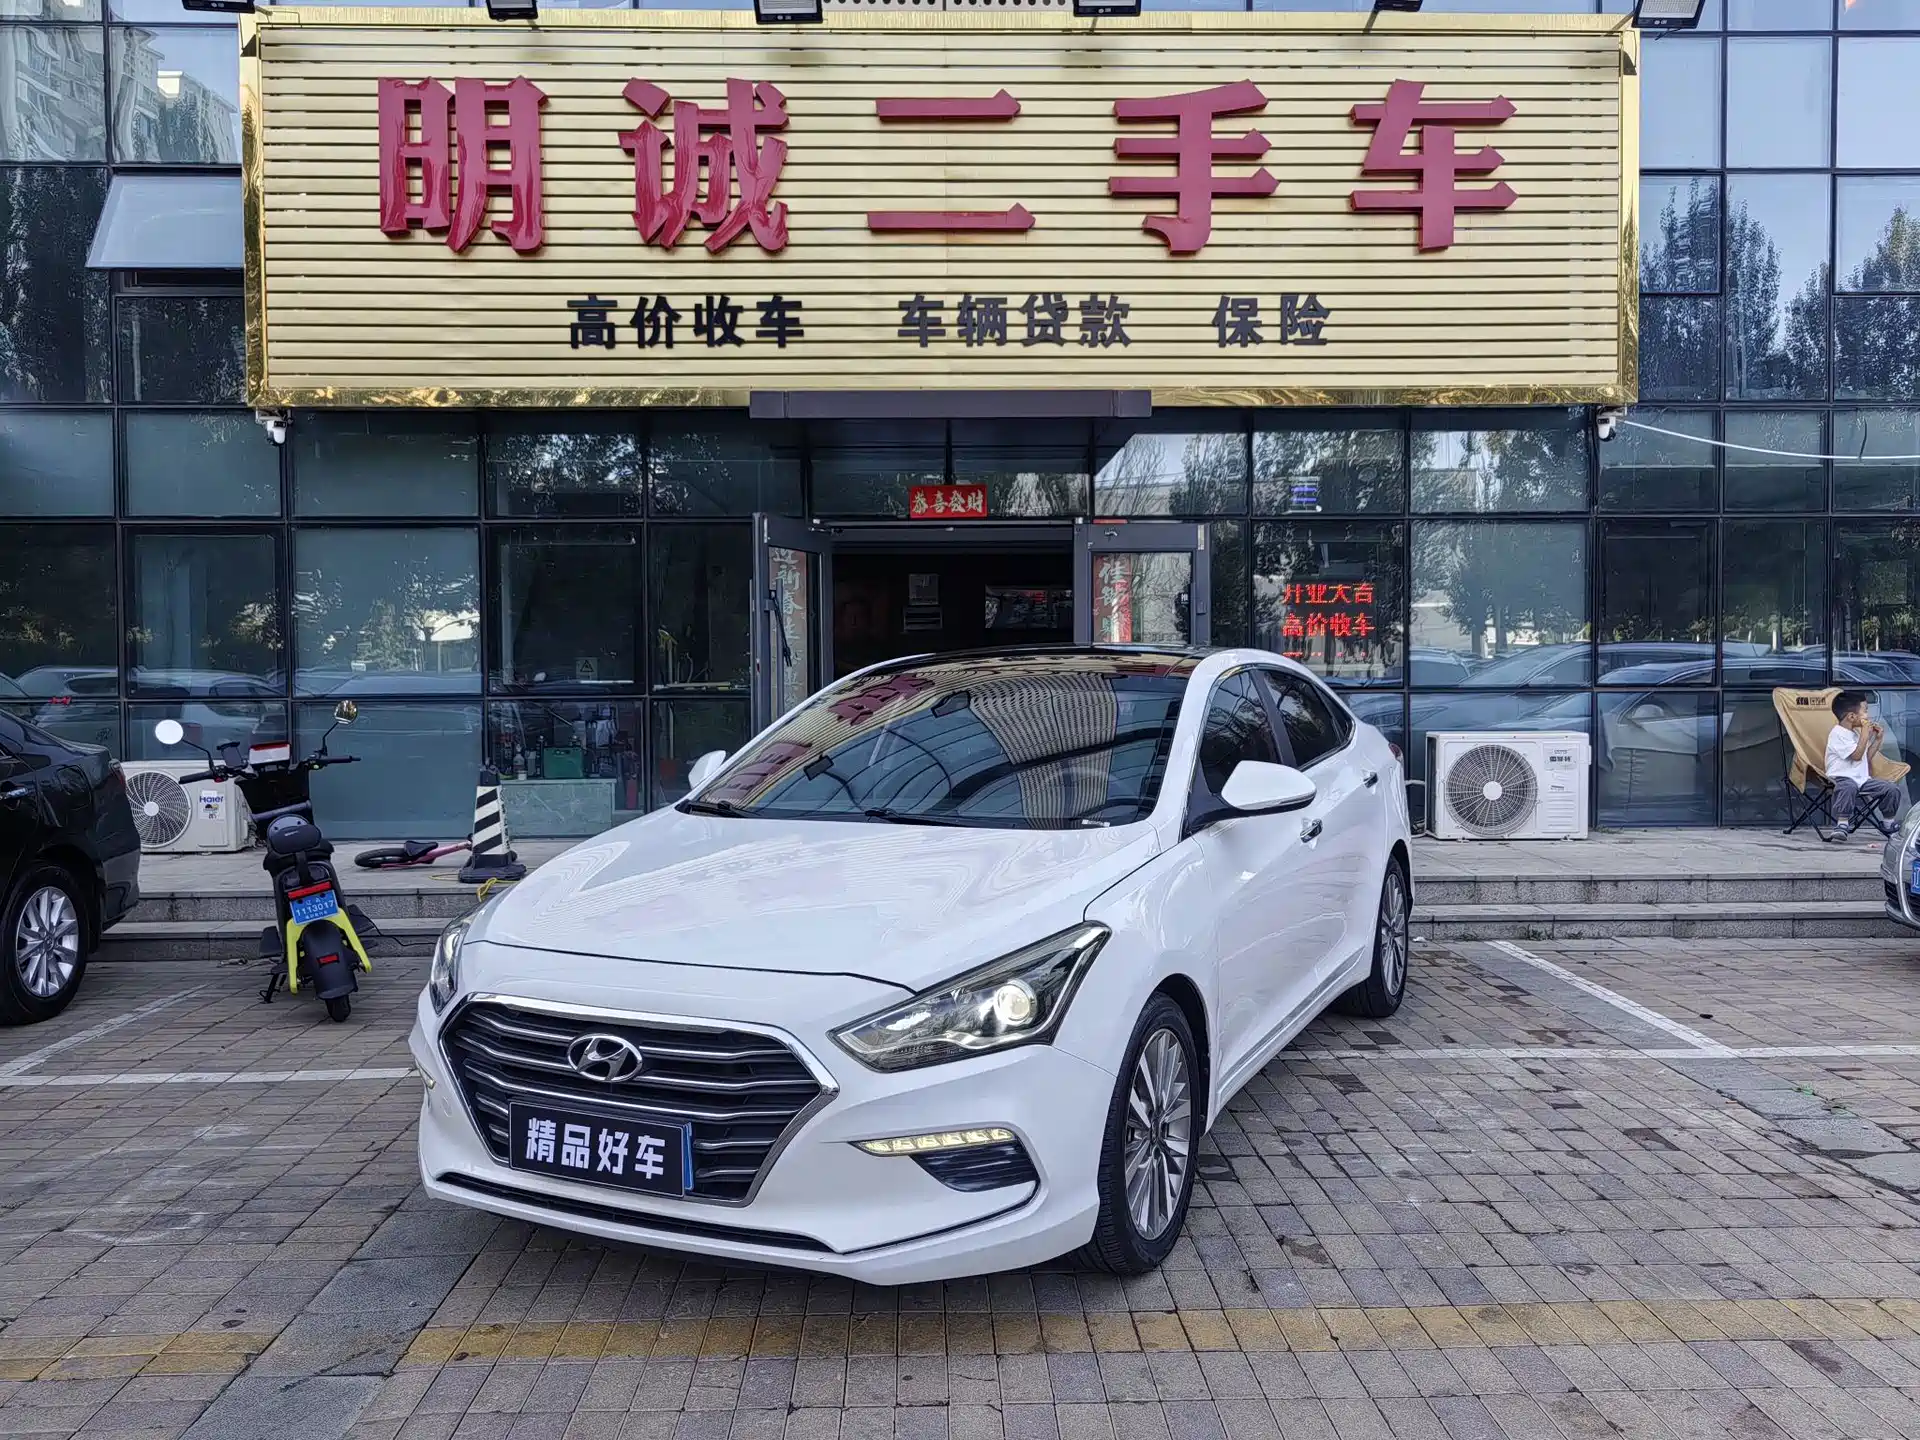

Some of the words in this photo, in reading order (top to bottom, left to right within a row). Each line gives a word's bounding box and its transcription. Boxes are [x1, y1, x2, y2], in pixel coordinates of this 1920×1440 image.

[378, 78, 1517, 254] 明诚二手车
[567, 294, 804, 349] 高价收车
[898, 293, 1131, 348] 车辆贷款
[1212, 293, 1331, 348] 保险
[1281, 611, 1376, 637] 高价收车
[199, 795, 224, 804] Haier
[525, 1117, 666, 1180] 精品好车
